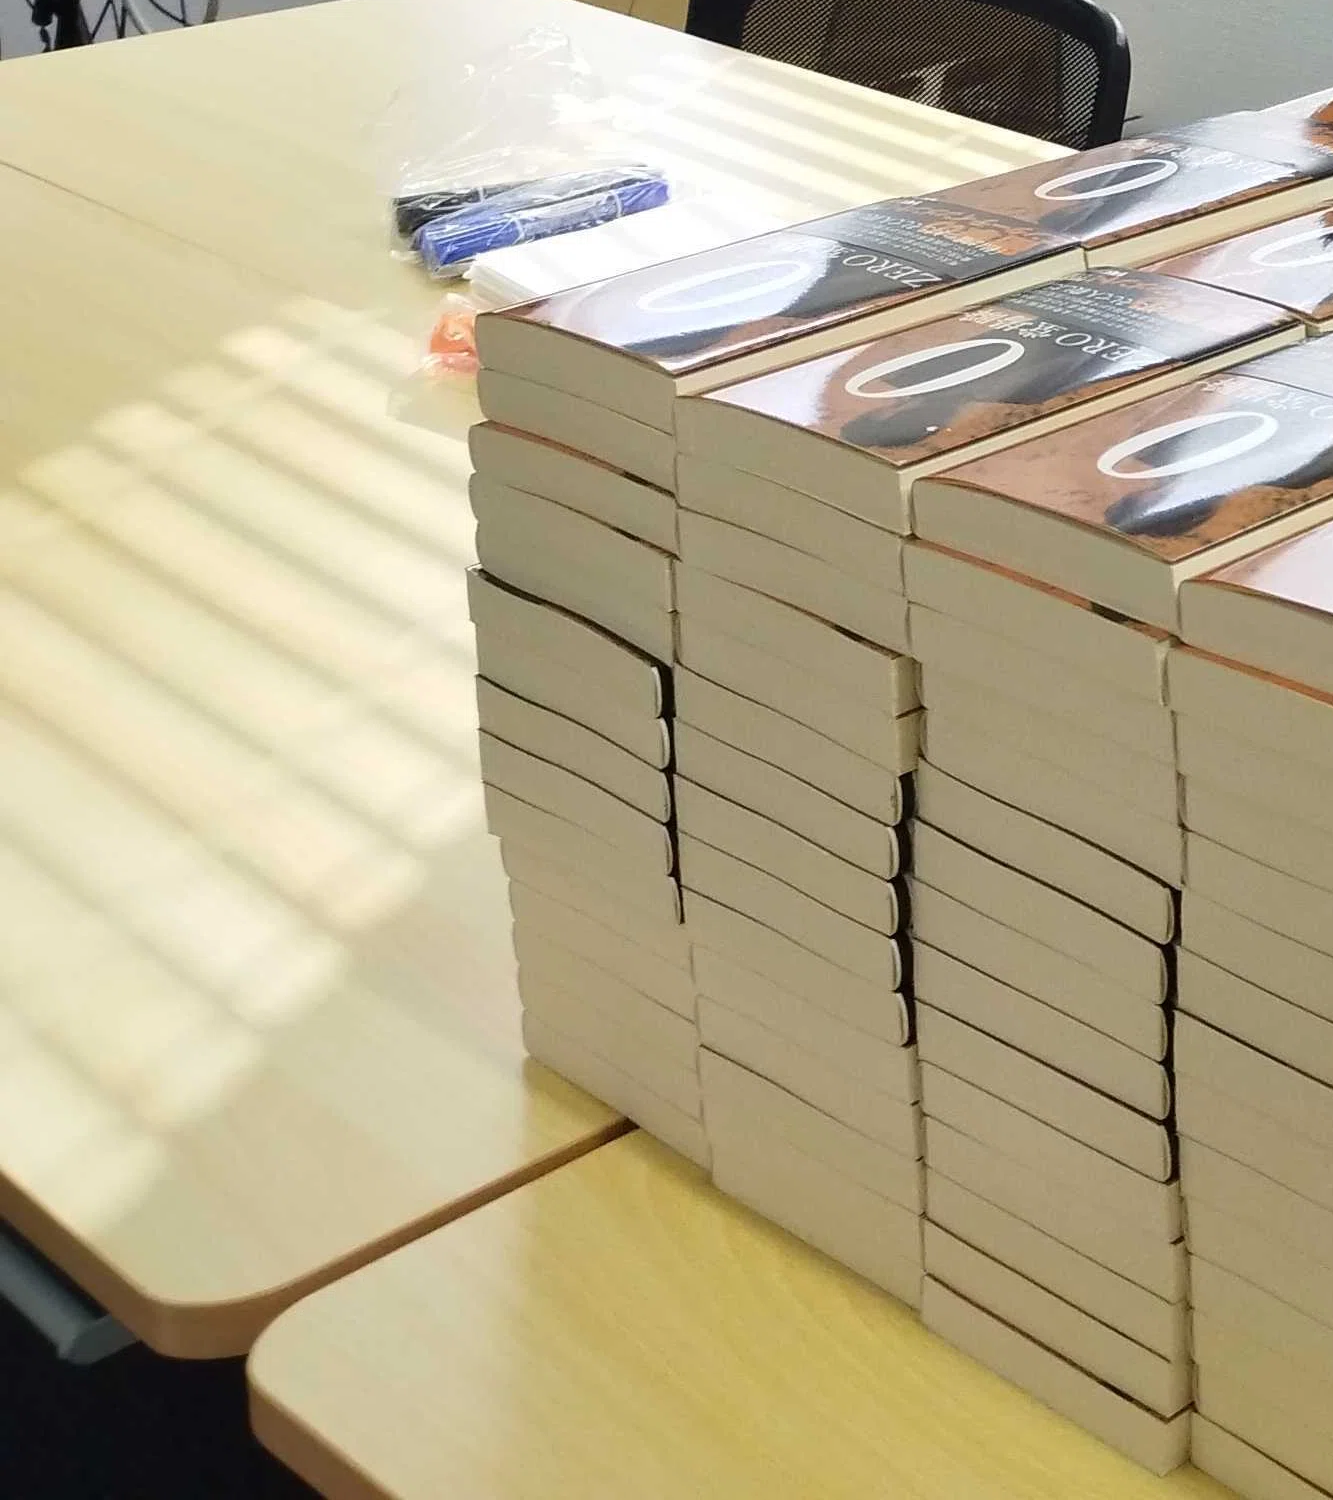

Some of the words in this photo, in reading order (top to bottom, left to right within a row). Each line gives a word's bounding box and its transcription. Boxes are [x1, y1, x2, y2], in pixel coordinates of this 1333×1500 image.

[1033, 159, 1177, 200] 0
[840, 253, 944, 287] ZERO
[843, 339, 1024, 397] 0
[1053, 332, 1168, 369] ERO
[1096, 411, 1277, 478] 0
